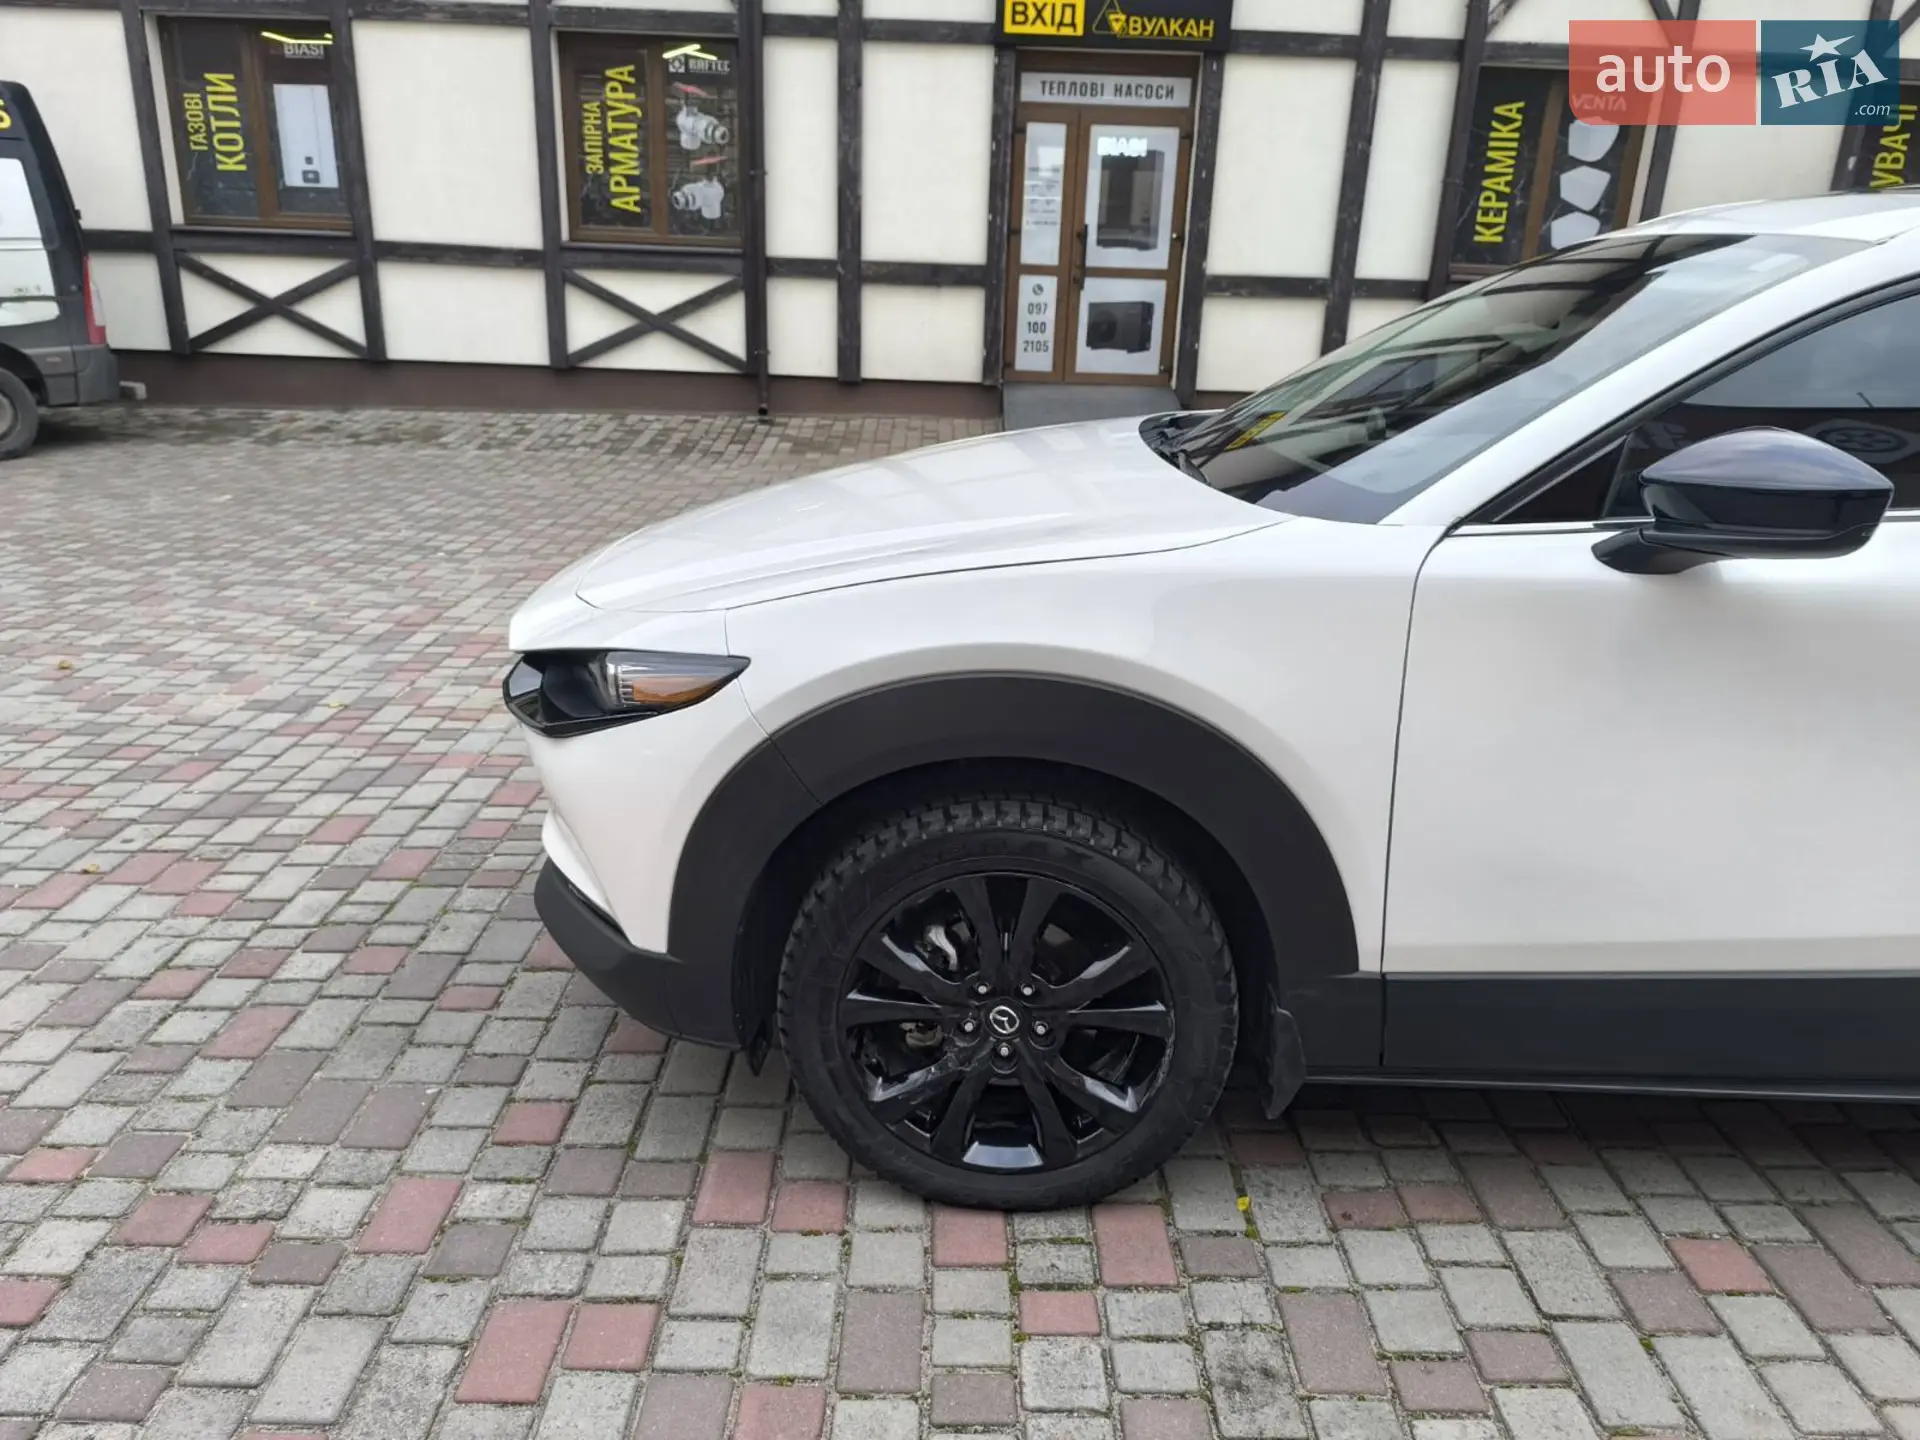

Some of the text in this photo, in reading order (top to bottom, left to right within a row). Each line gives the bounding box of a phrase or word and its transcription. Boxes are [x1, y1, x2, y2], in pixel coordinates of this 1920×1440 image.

[1010, 0, 1077, 33] ВХІД
[1128, 15, 1215, 38] ВУЛКАН
[1040, 80, 1175, 100] ТЕПЛОВІ НАСОСИ
[183, 92, 208, 151] ГАЗОВІ
[203, 73, 248, 171] КОТЛИ
[582, 100, 604, 175] ЗАПІРНА
[604, 64, 642, 213] АРМАТУРА
[1473, 101, 1526, 243] КЕРАМІКА
[1027, 302, 1048, 316] 097
[1027, 320, 1047, 334] 100
[1023, 340, 1049, 354] 2105
